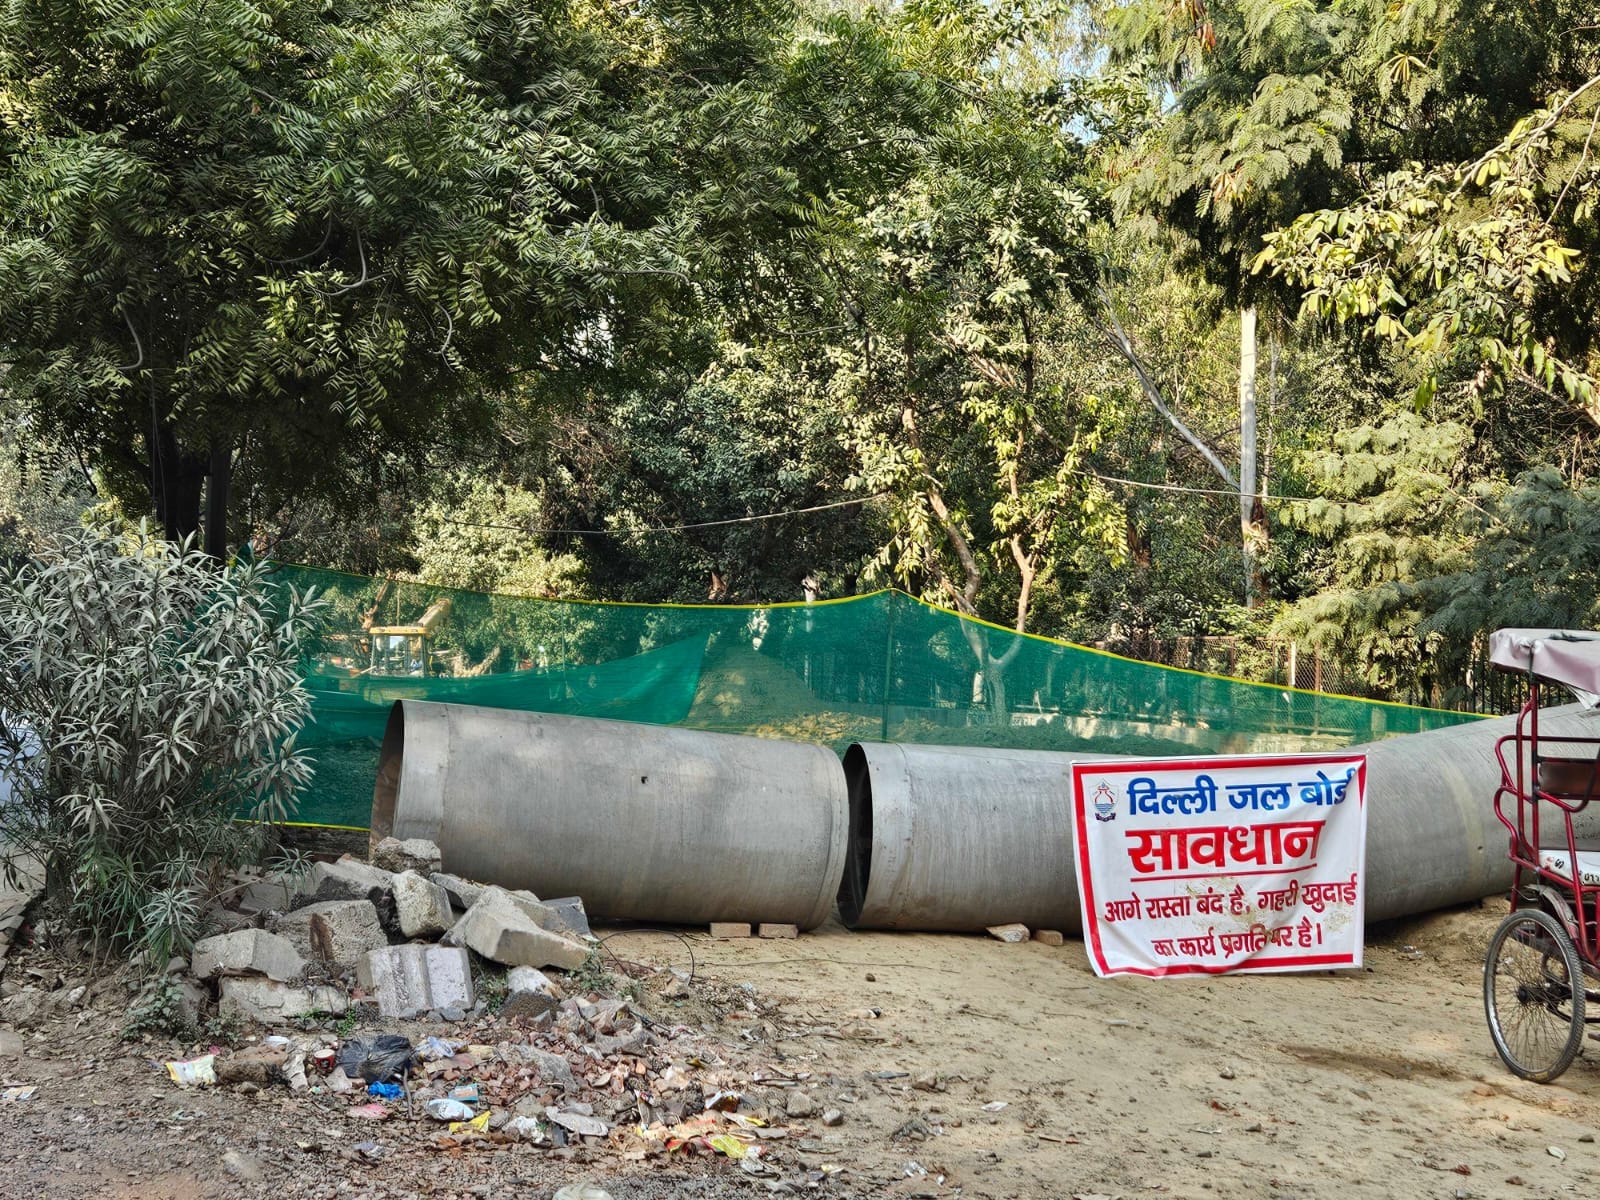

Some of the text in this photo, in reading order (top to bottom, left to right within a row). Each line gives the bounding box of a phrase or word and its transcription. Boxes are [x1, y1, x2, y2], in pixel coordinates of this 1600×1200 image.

[1126, 767, 1356, 815] दिल्ली जल बोर्ड
[1125, 820, 1326, 873] सावधान
[1104, 892, 1142, 922] आगे
[1144, 896, 1191, 919] रास्ता
[1196, 886, 1225, 915] बंद
[1257, 879, 1299, 912] गहरी
[1301, 873, 1358, 913] खुदाई
[1151, 939, 1178, 957] का
[1177, 926, 1216, 957] कार्य
[1218, 923, 1268, 959] प्रगति
[1270, 926, 1294, 947] पर
